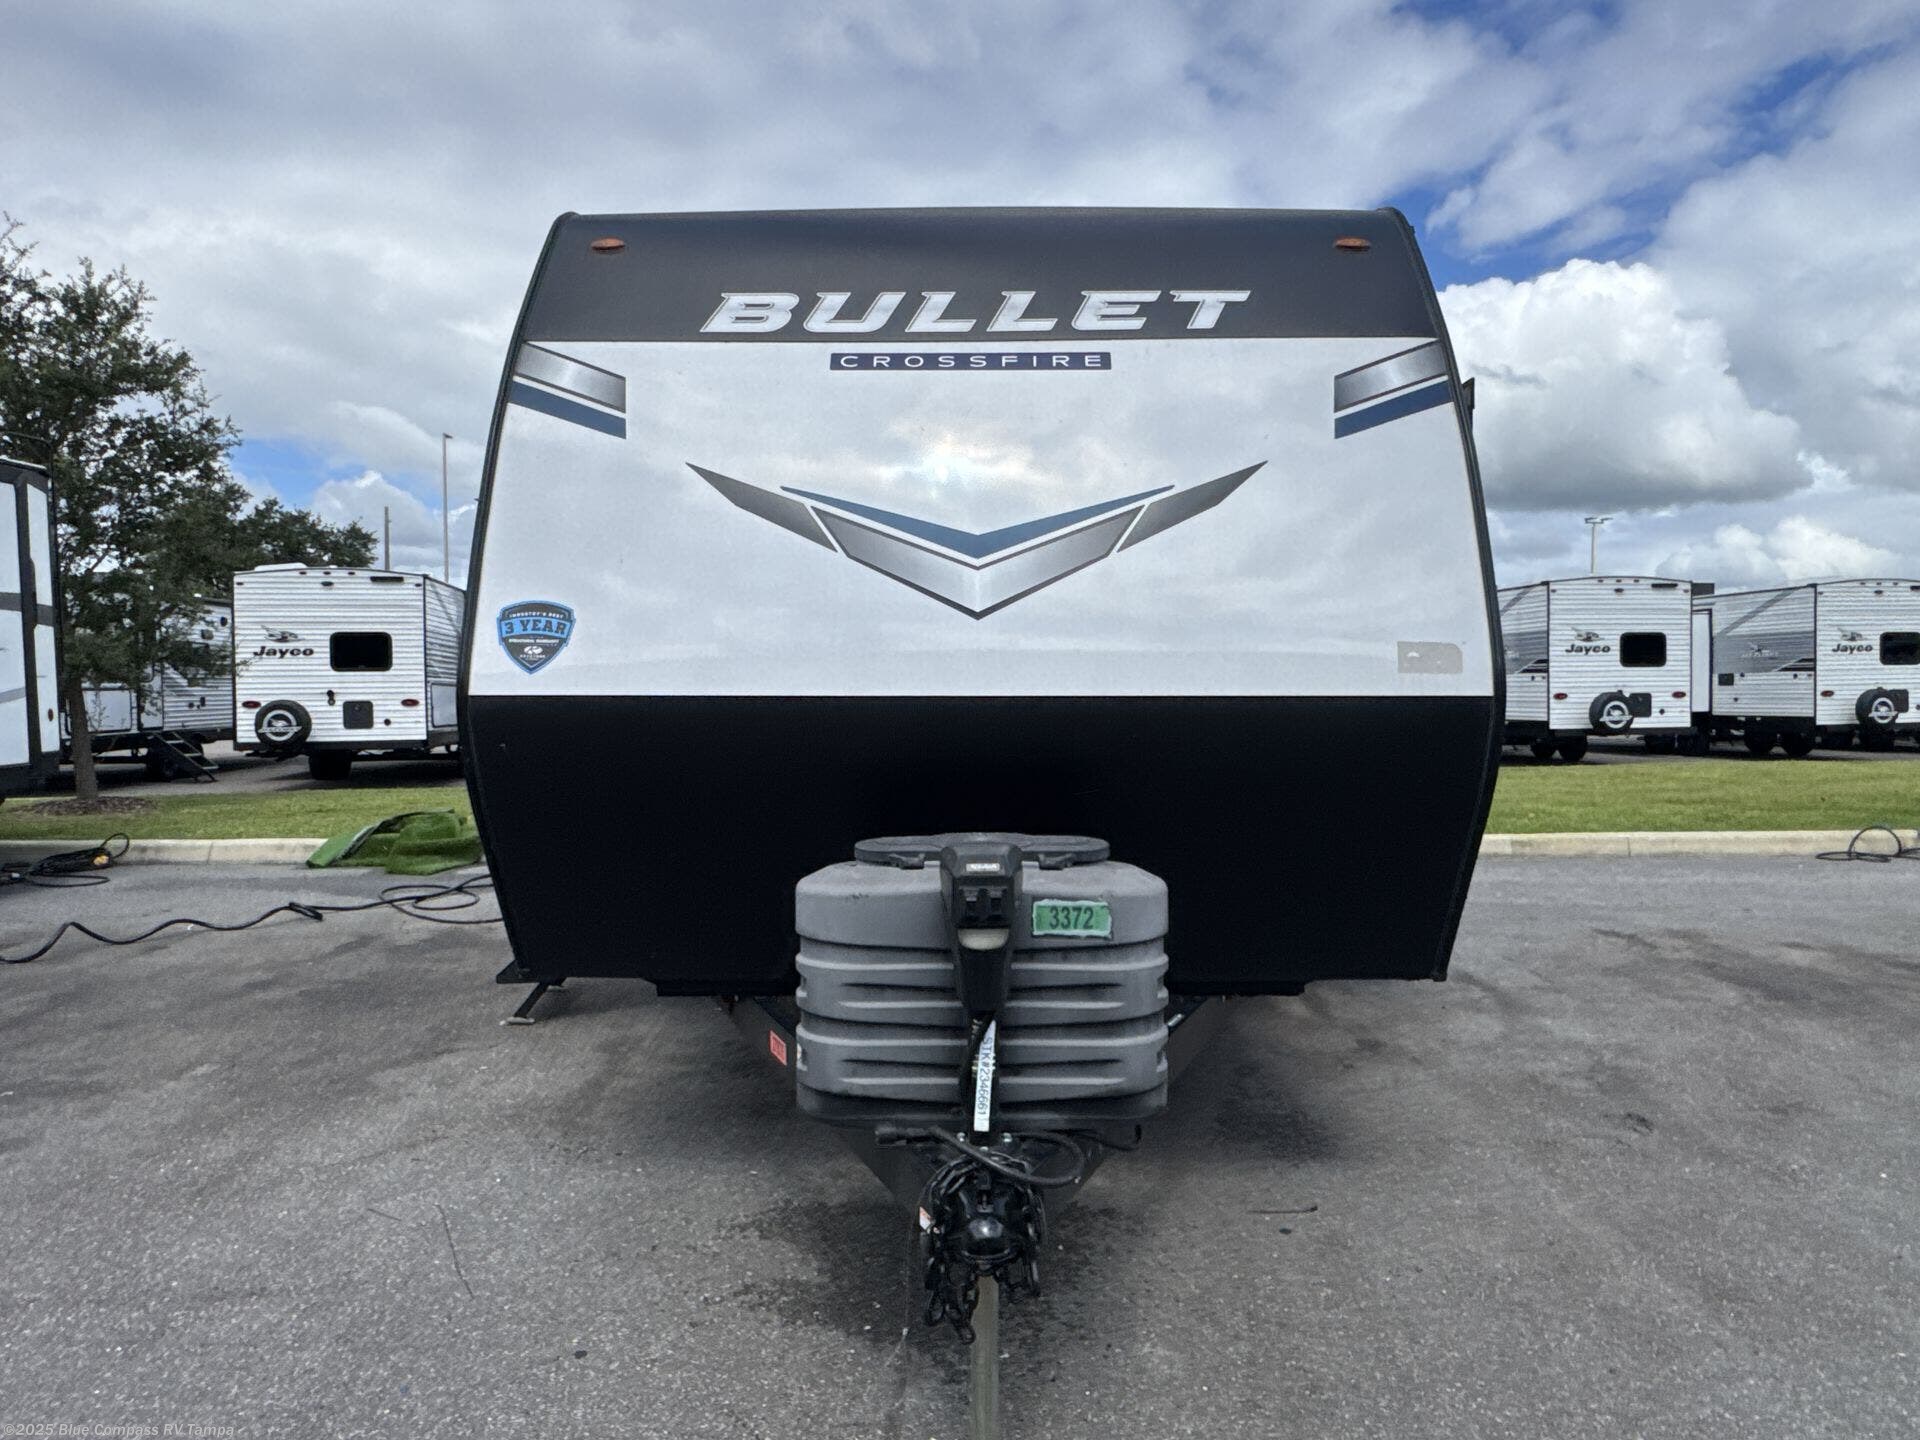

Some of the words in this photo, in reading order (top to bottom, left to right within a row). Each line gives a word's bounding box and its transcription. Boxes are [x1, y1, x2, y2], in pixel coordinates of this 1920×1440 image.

[700, 290, 1251, 333] BULLET
[840, 355, 1101, 368] CROSSFIRE
[504, 621, 514, 635] 3
[520, 619, 567, 635] YEAR
[253, 646, 315, 659] Jayco
[1565, 643, 1611, 656] Jayco
[1832, 643, 1873, 655] Jayco
[1049, 906, 1094, 930] 3372
